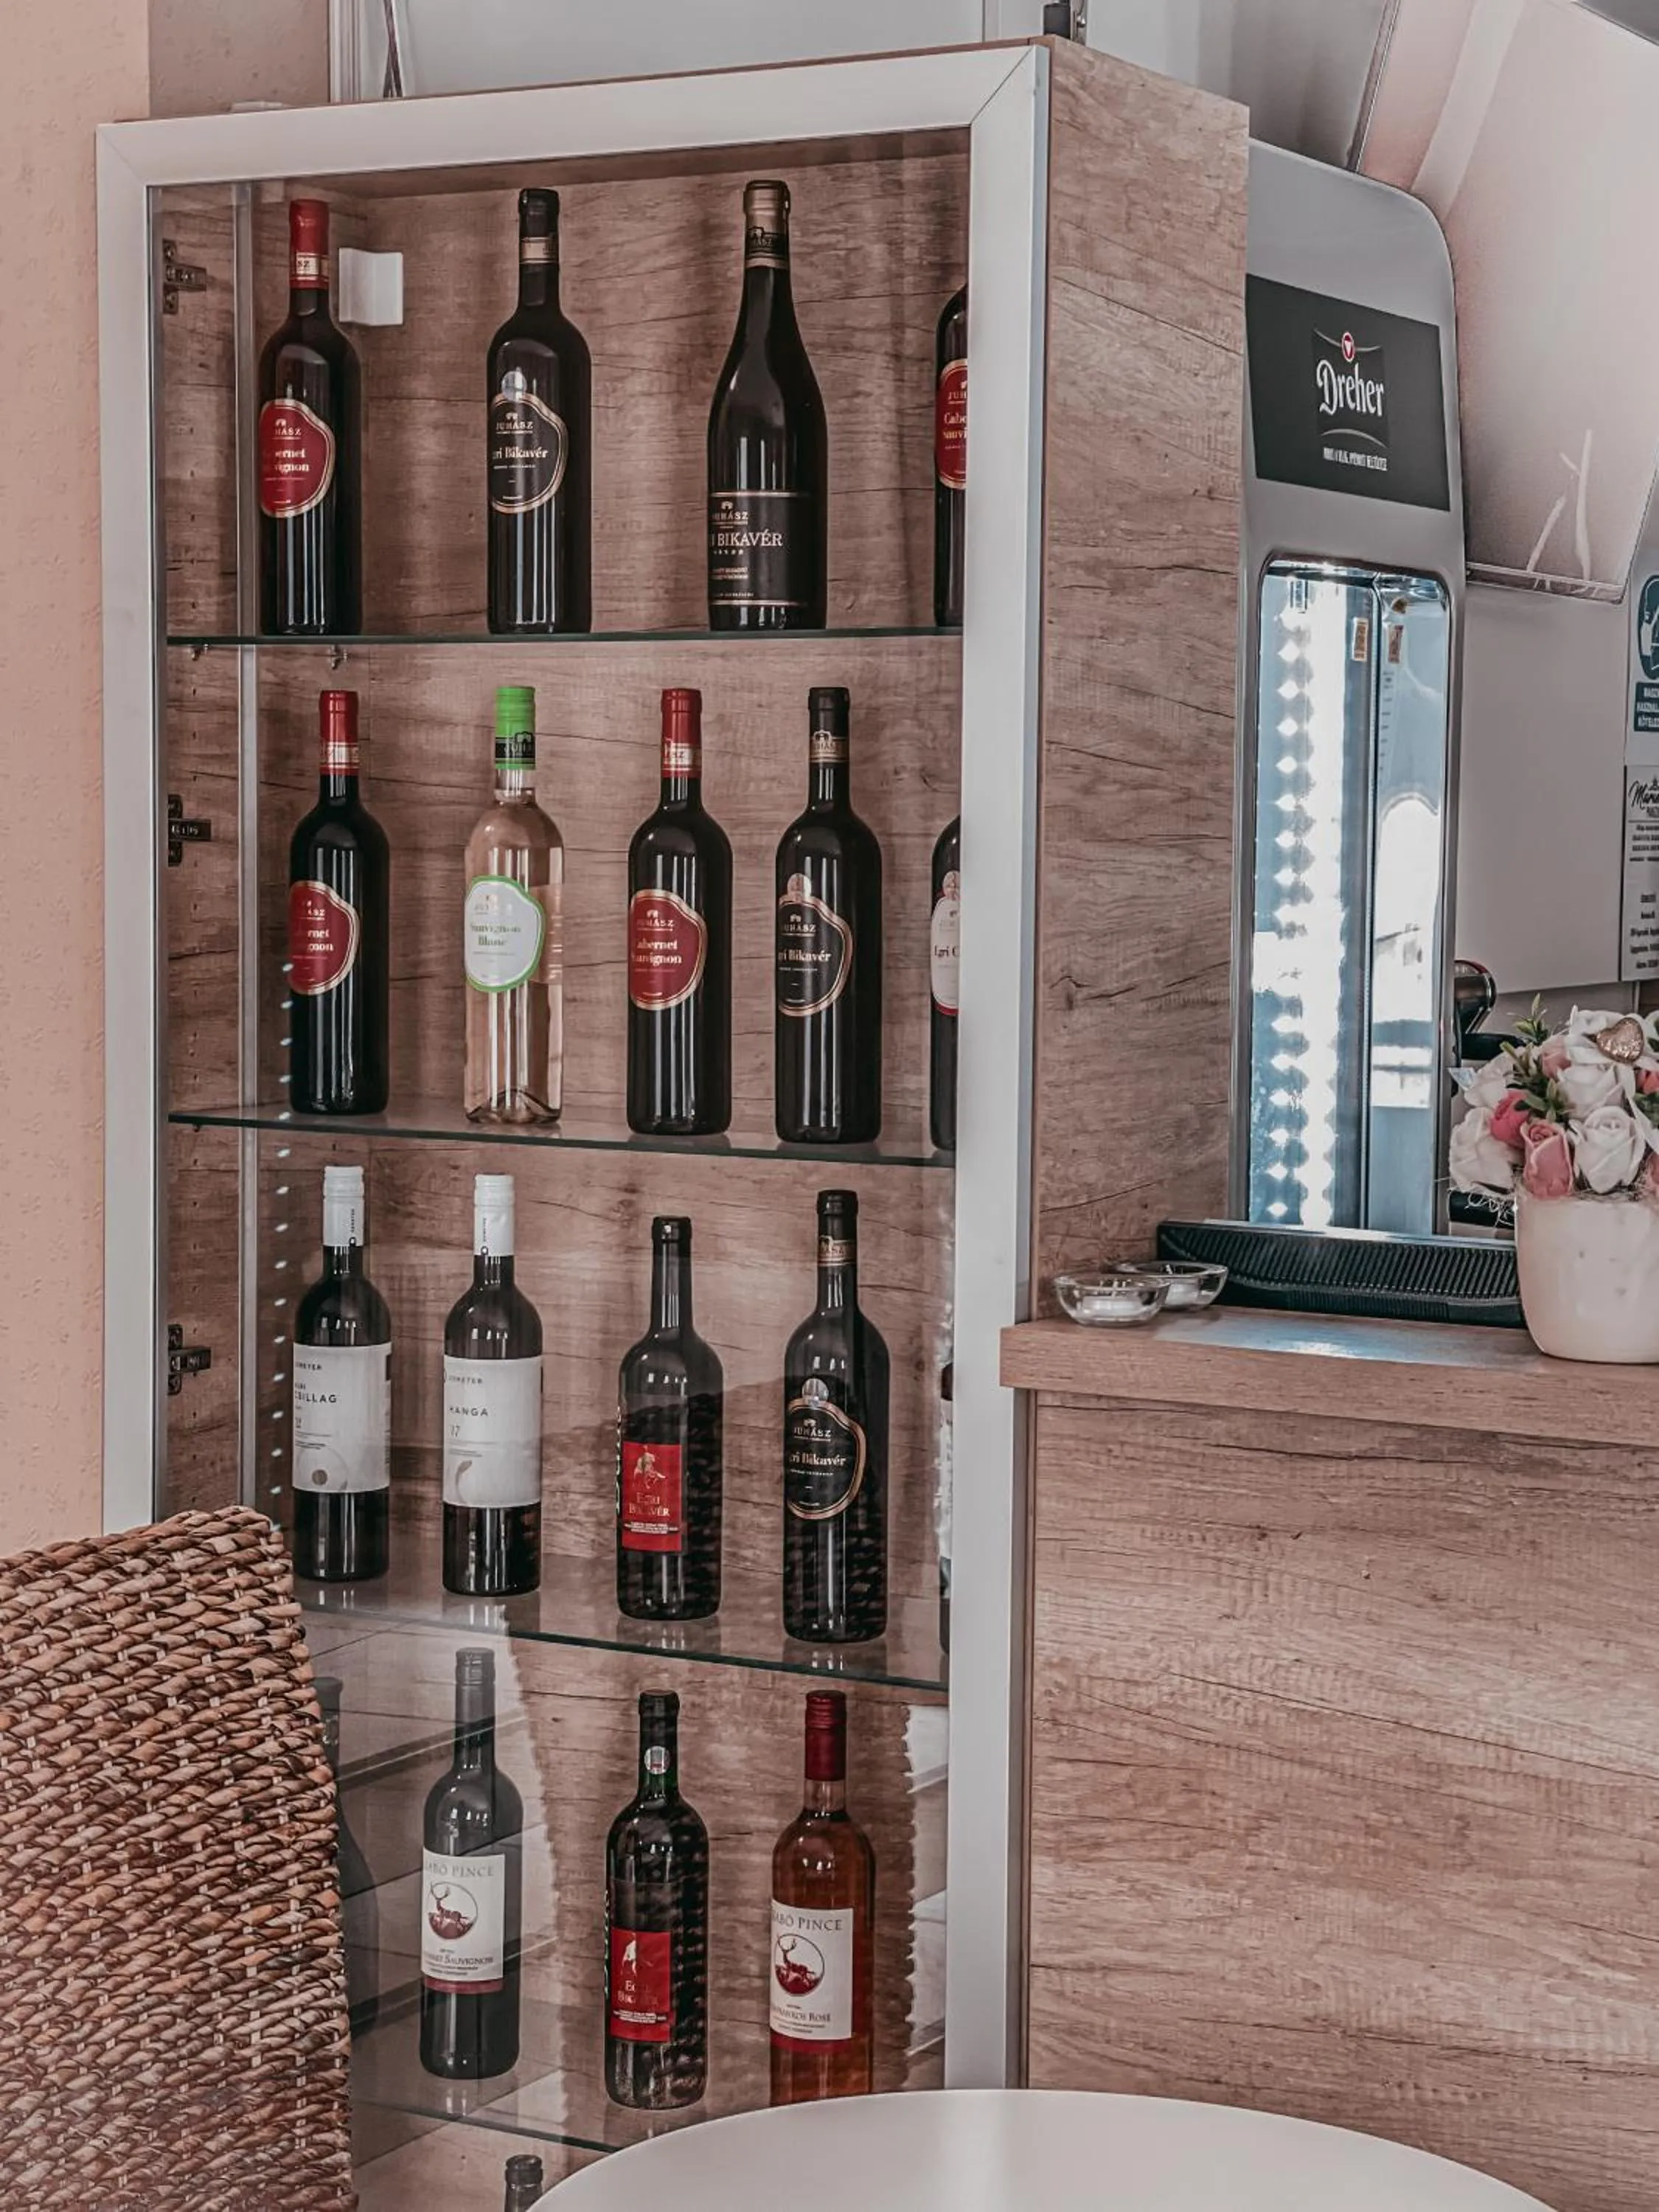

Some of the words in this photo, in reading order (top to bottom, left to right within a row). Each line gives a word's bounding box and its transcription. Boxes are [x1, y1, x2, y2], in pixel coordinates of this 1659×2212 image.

[1316, 359, 1385, 417] Dreher
[505, 446, 549, 459] Bikavér
[717, 529, 783, 546] BIKAVÉR
[802, 1452, 846, 1466] Bikavér
[799, 1916, 843, 1931] PINCE
